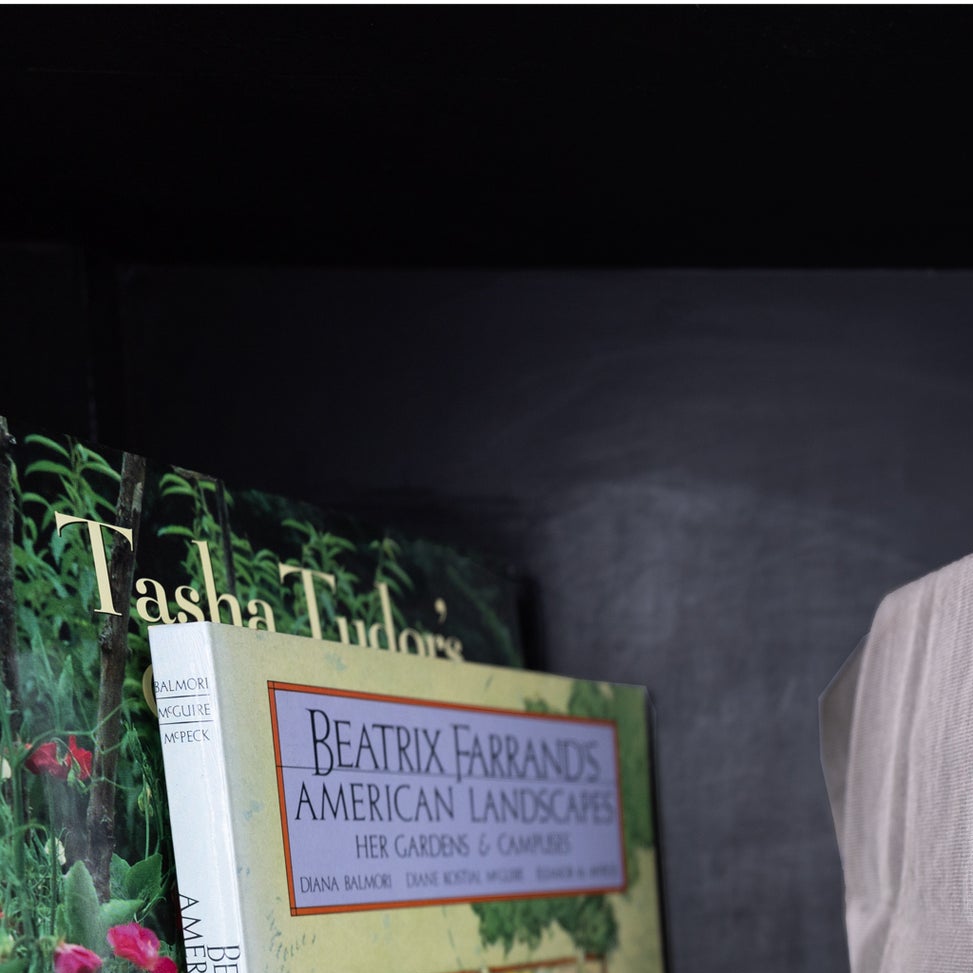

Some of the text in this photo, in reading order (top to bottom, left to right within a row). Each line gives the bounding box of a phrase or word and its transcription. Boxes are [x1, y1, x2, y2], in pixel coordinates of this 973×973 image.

[54, 511, 465, 663] Tasha Tudor's
[154, 677, 209, 693] BALMORI
[306, 708, 446, 776] BEATRIX
[295, 780, 616, 826] AMERICAN LANDSCAPES
[355, 834, 389, 859] HER
[394, 832, 470, 859] GARDENS
[300, 875, 339, 894] DIANA
